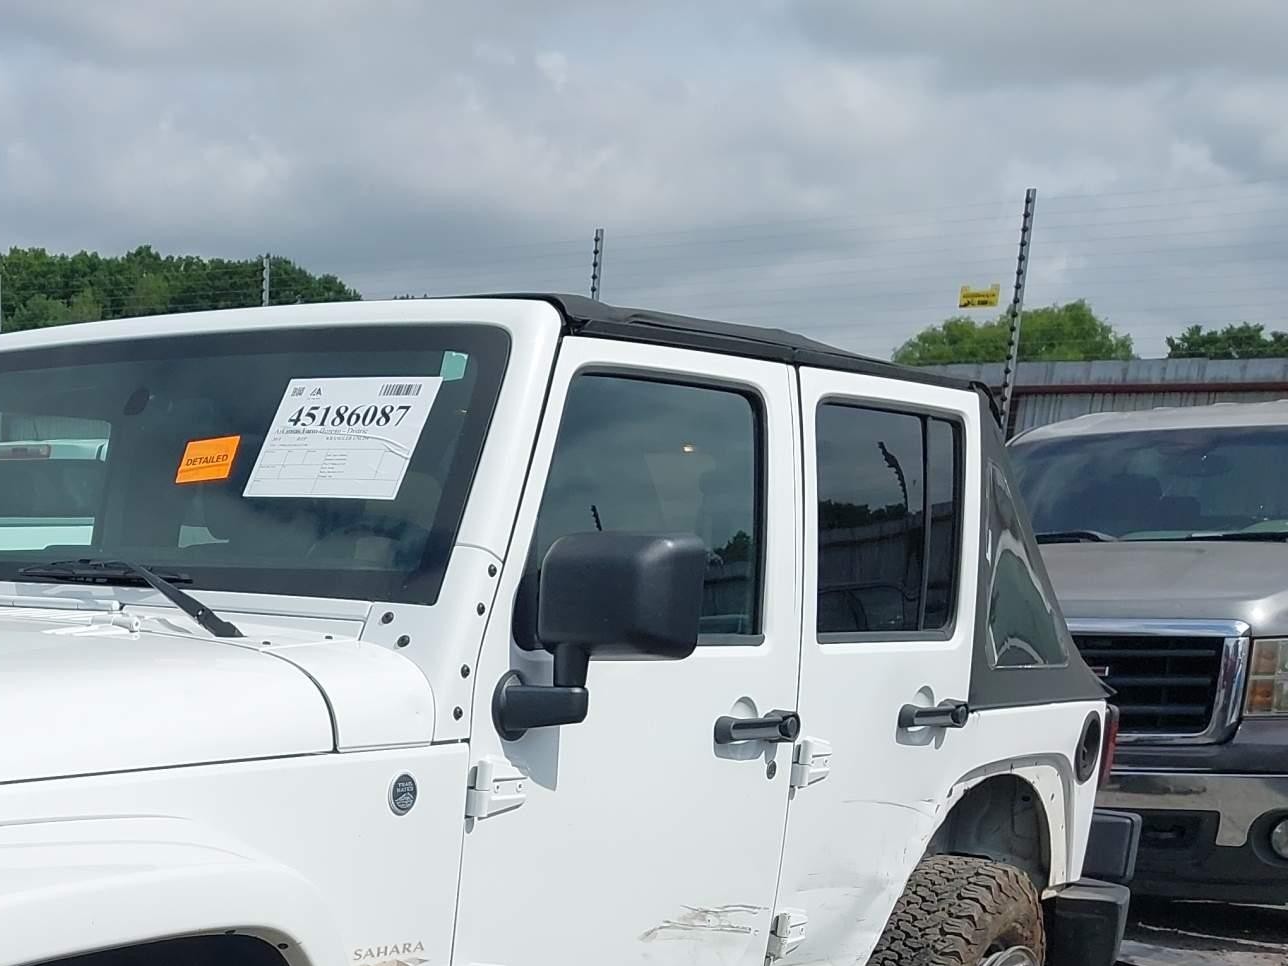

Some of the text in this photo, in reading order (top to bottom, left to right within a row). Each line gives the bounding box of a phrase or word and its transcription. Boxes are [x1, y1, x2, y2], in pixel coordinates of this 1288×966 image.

[288, 404, 411, 427] 45186087
[185, 453, 229, 467] DETAILED
[353, 941, 424, 960] SAHARA
